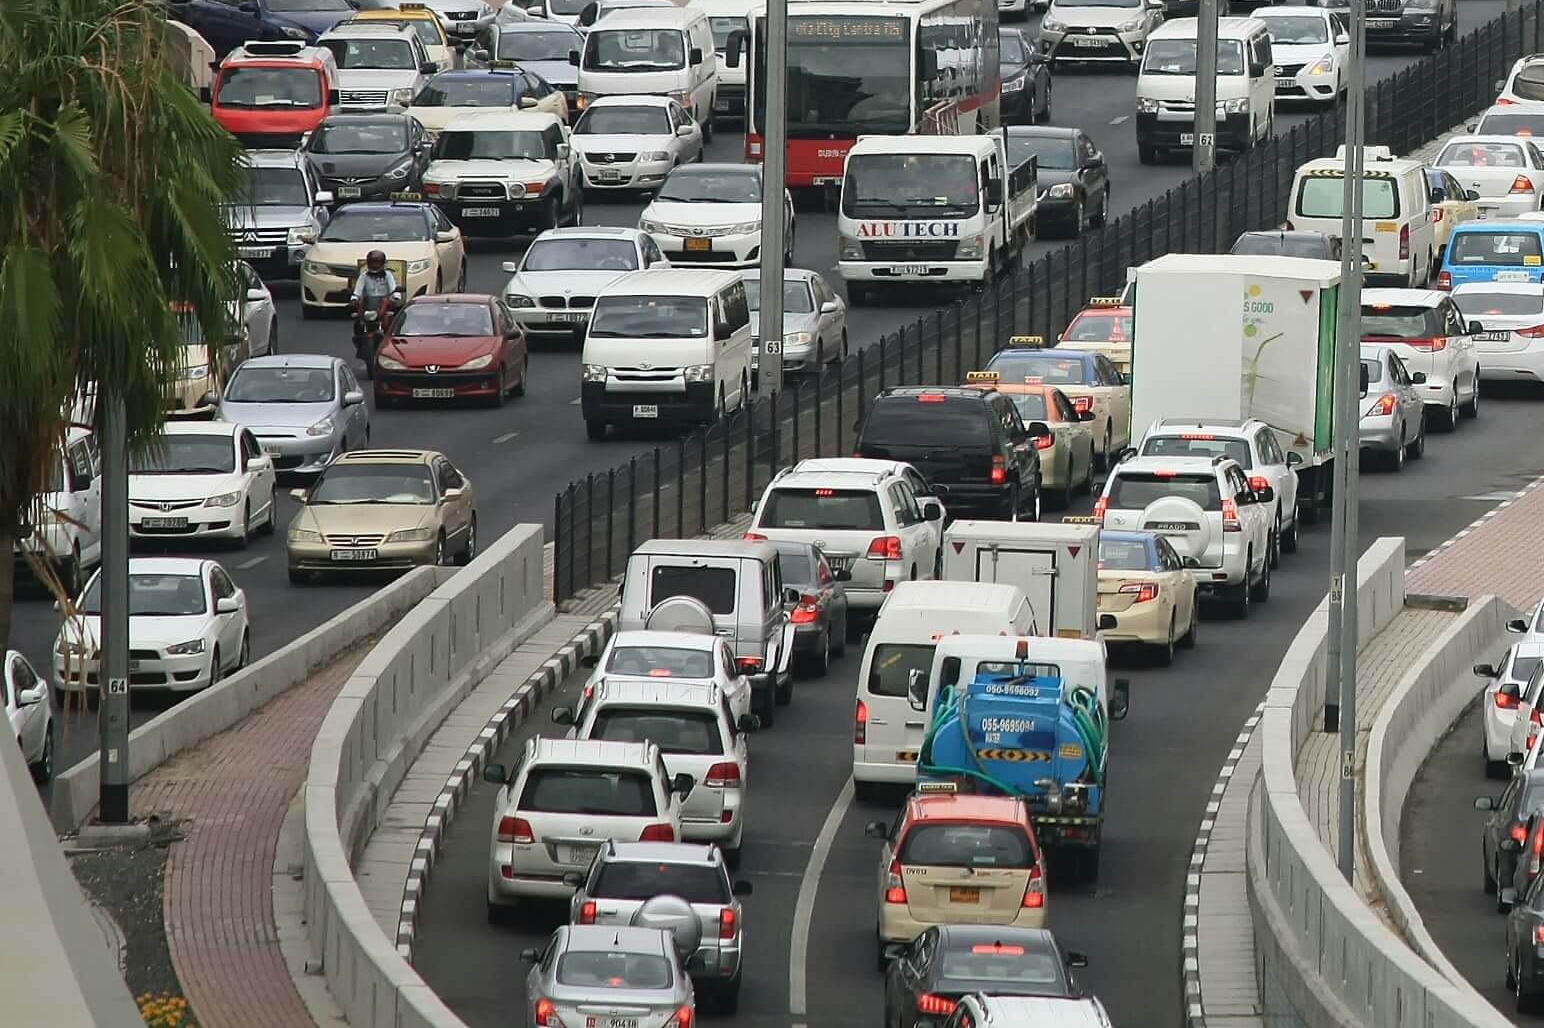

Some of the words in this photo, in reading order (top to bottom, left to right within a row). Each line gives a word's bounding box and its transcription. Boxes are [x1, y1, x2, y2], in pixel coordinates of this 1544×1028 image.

[857, 222, 897, 237] ALU
[900, 222, 958, 237] TECH
[1251, 302, 1274, 313] GOOD
[768, 342, 780, 353] 63
